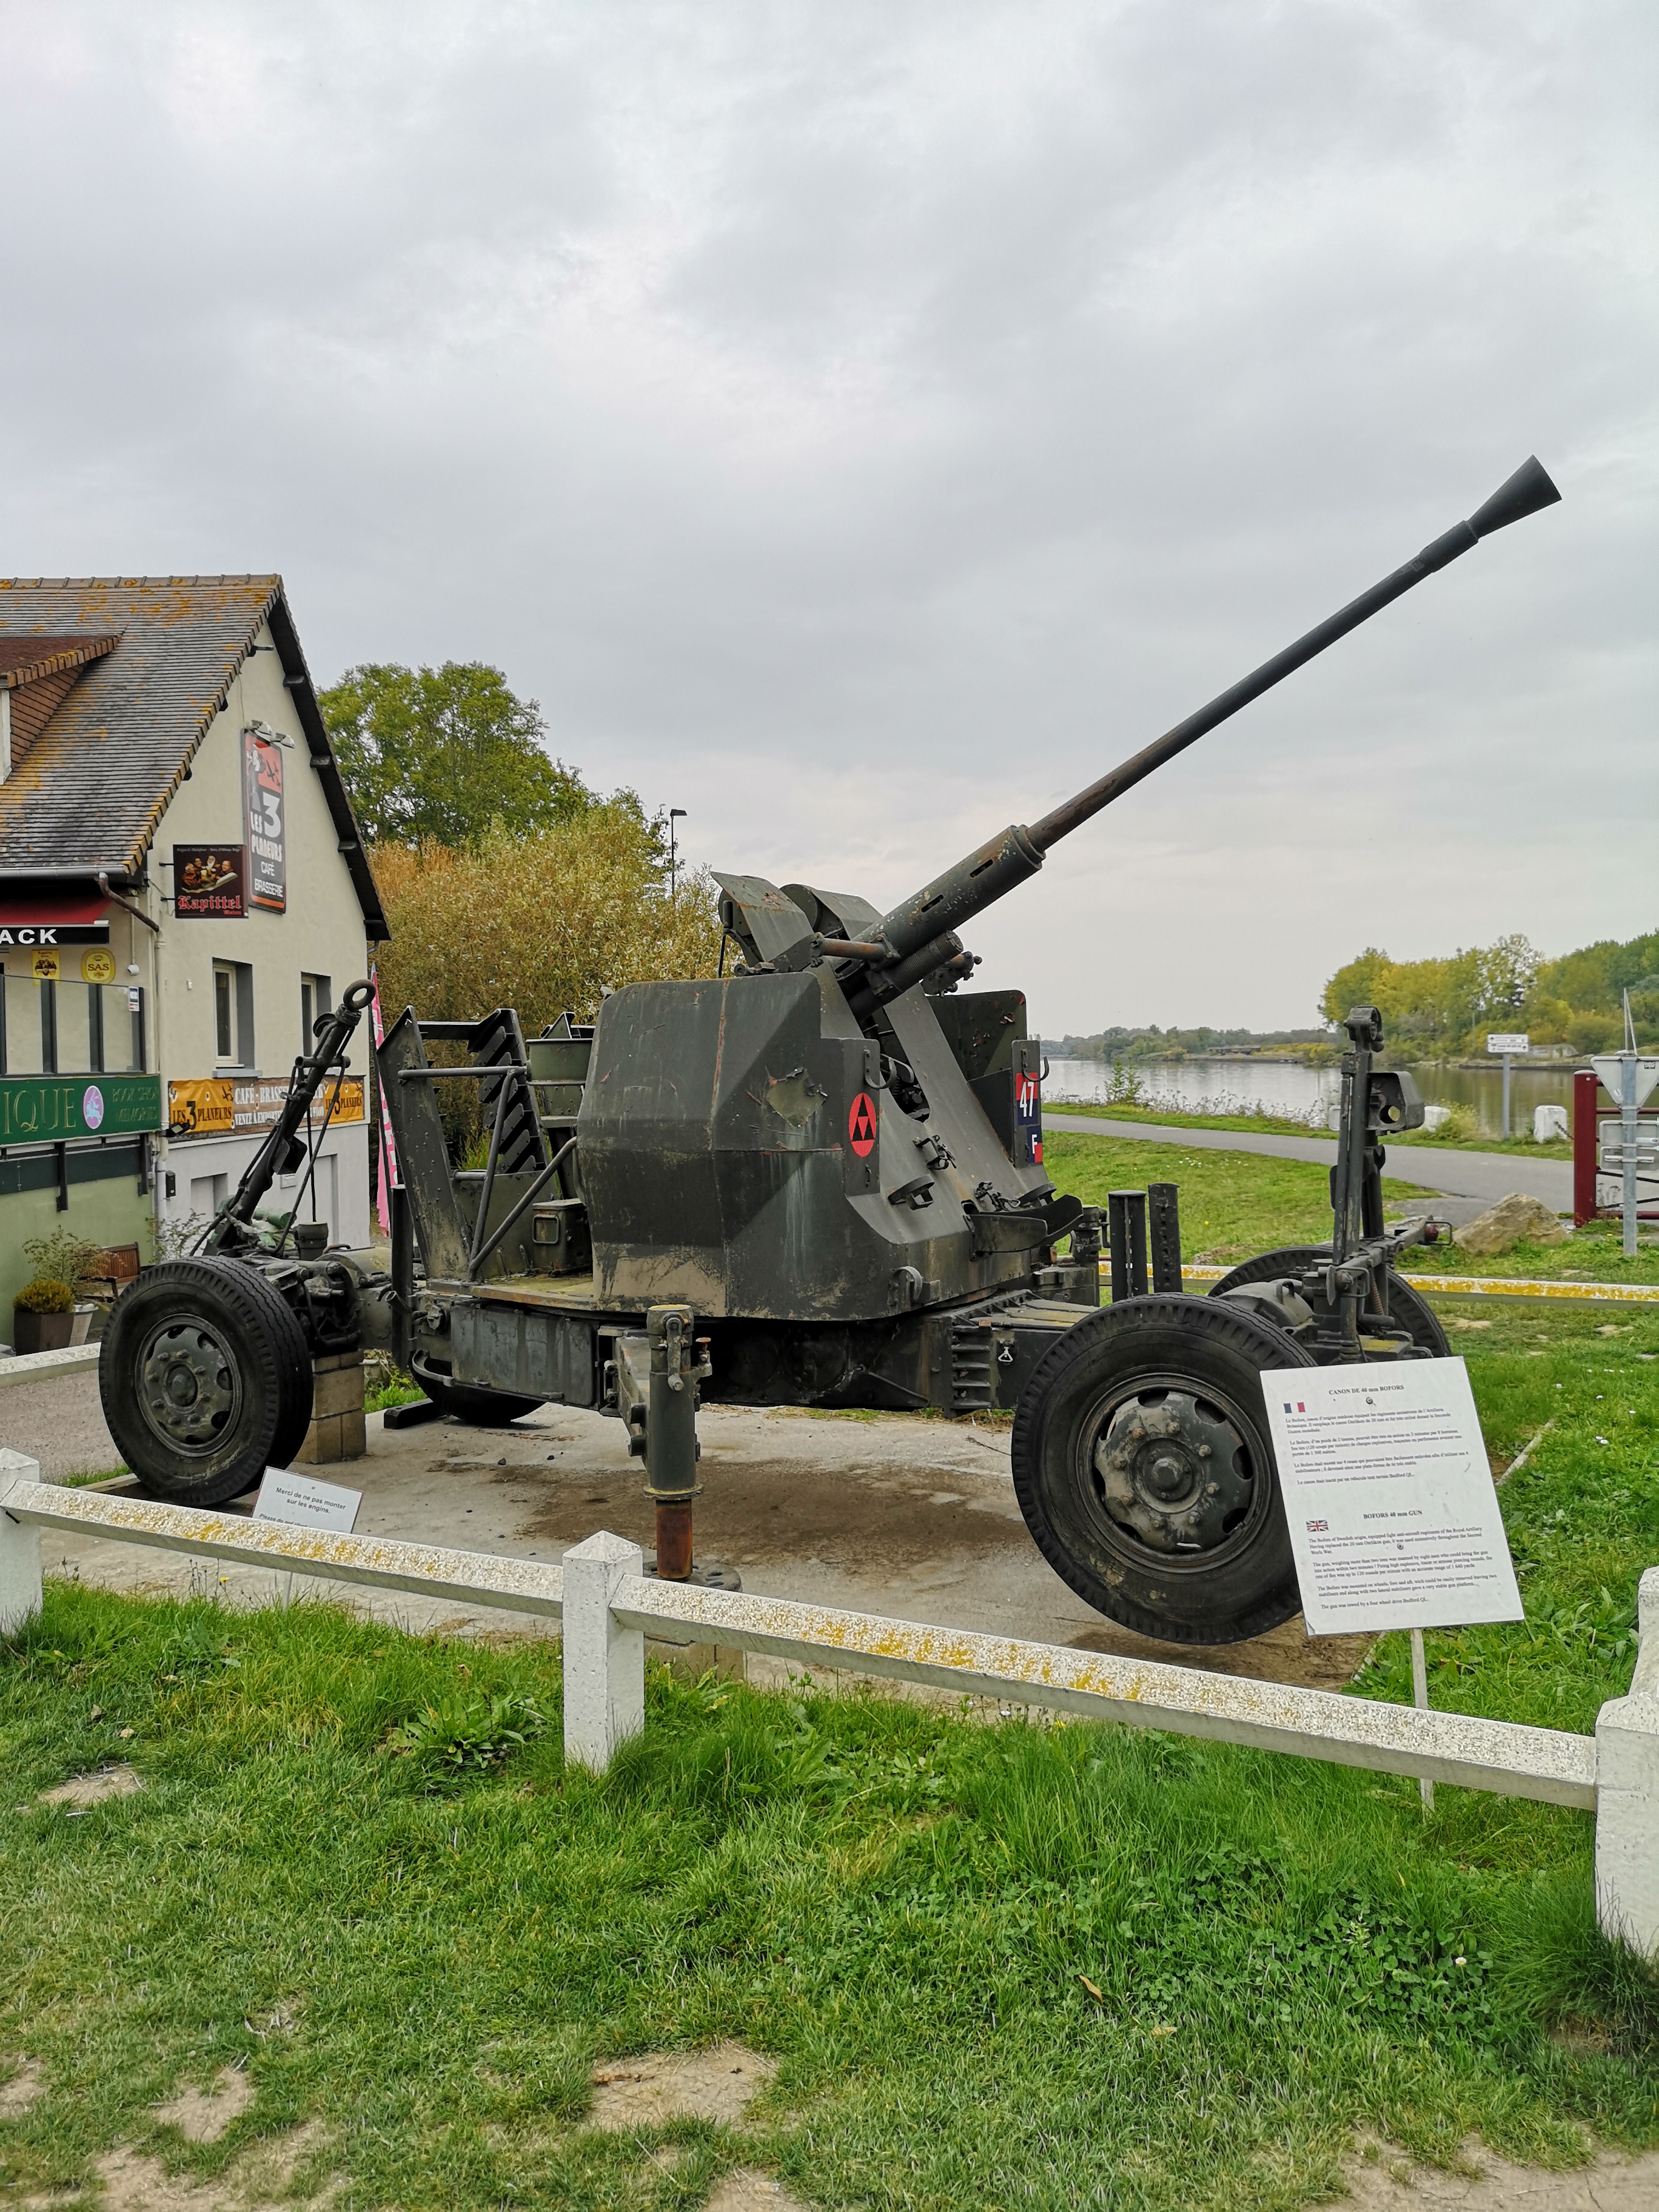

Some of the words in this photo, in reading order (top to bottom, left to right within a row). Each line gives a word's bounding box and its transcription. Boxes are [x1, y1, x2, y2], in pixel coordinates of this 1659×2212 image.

[250, 811, 262, 834] LES
[263, 791, 281, 838] 3
[252, 834, 282, 862] PLANEURS
[261, 861, 275, 876] CAFÉ
[255, 878, 283, 897] BRASSERIE
[178, 896, 241, 912] Kapittel
[0, 929, 57, 944] ACK
[235, 1084, 255, 1104] CAFÉ
[1020, 1082, 1034, 1117] 47
[173, 1108, 186, 1125] LES
[186, 1101, 197, 1130] 3
[198, 1107, 232, 1121] PLANEURS
[234, 1113, 253, 1125] VENTE
[1031, 1134, 1038, 1154] F
[276, 1487, 293, 1496] Merci
[324, 1501, 346, 1510] monter
[308, 1504, 330, 1513] engins.
